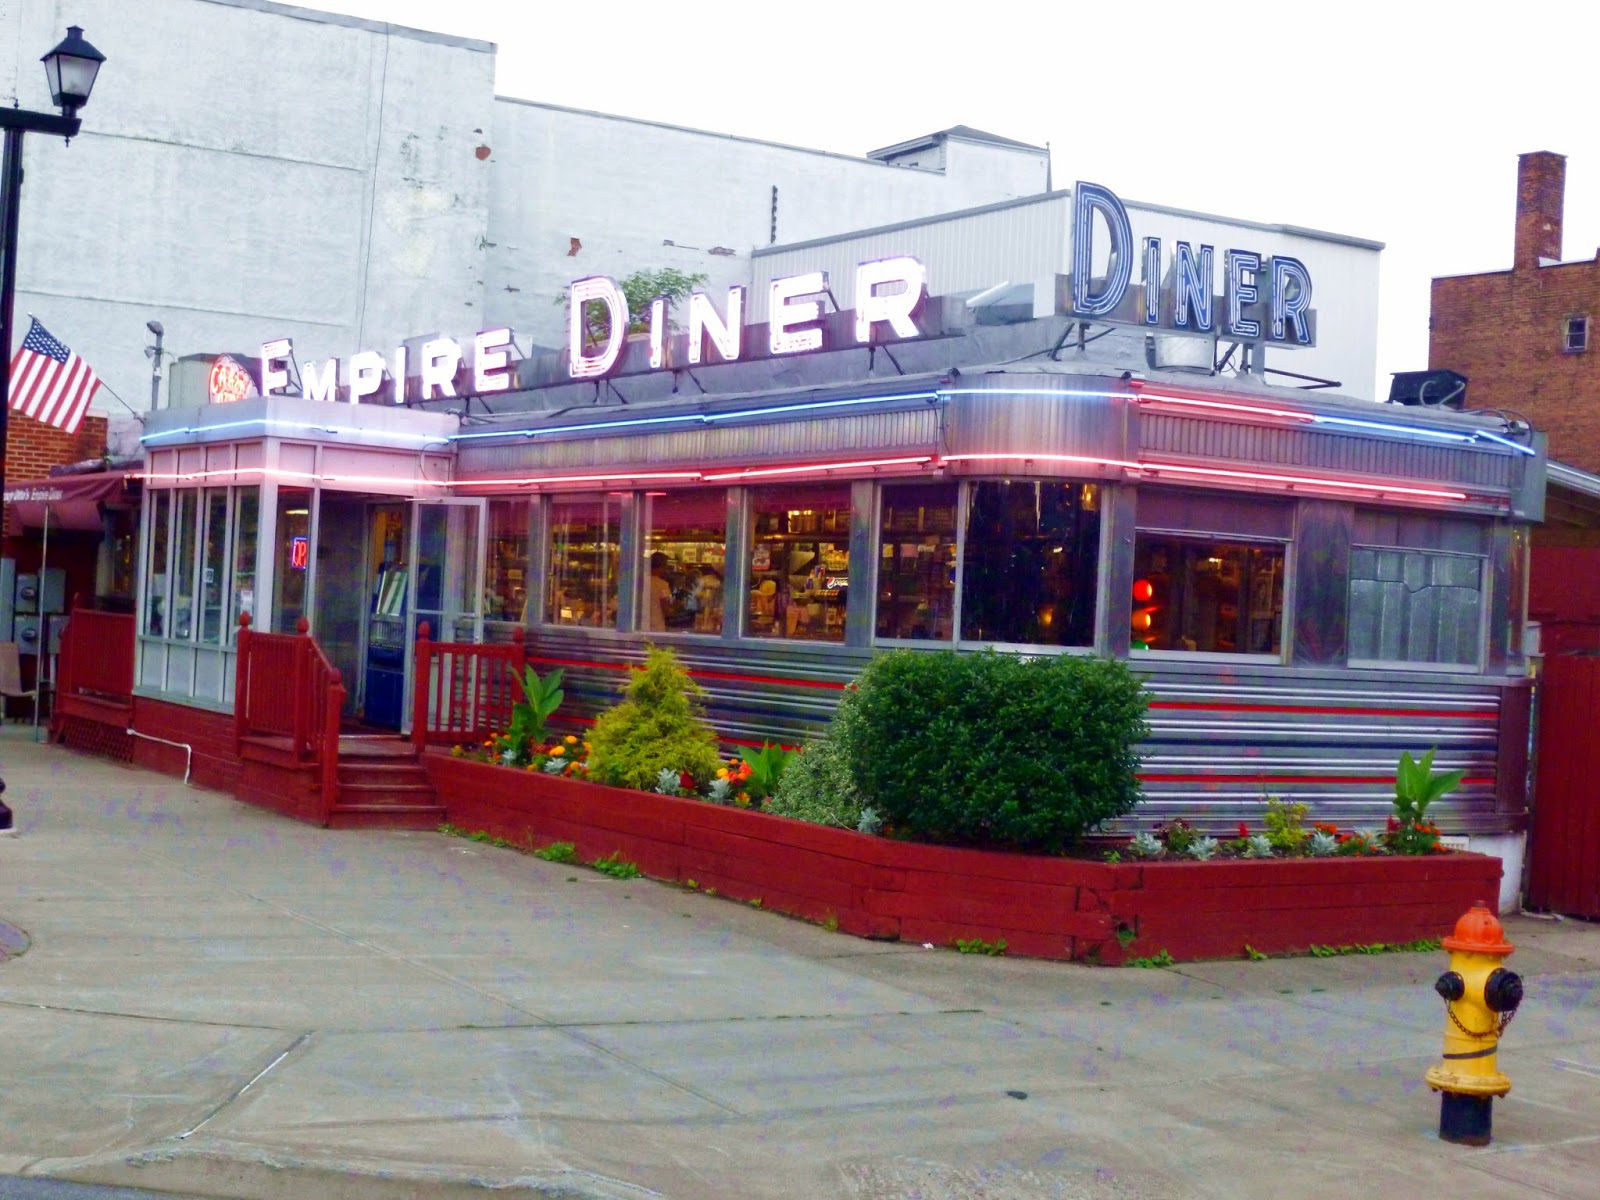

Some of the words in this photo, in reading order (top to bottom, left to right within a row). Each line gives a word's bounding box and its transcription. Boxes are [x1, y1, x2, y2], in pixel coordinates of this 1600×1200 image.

[261, 327, 515, 404] EMPIRE
[569, 255, 926, 379] DINER
[1071, 180, 1313, 345] DINER
[292, 540, 307, 567] OP
